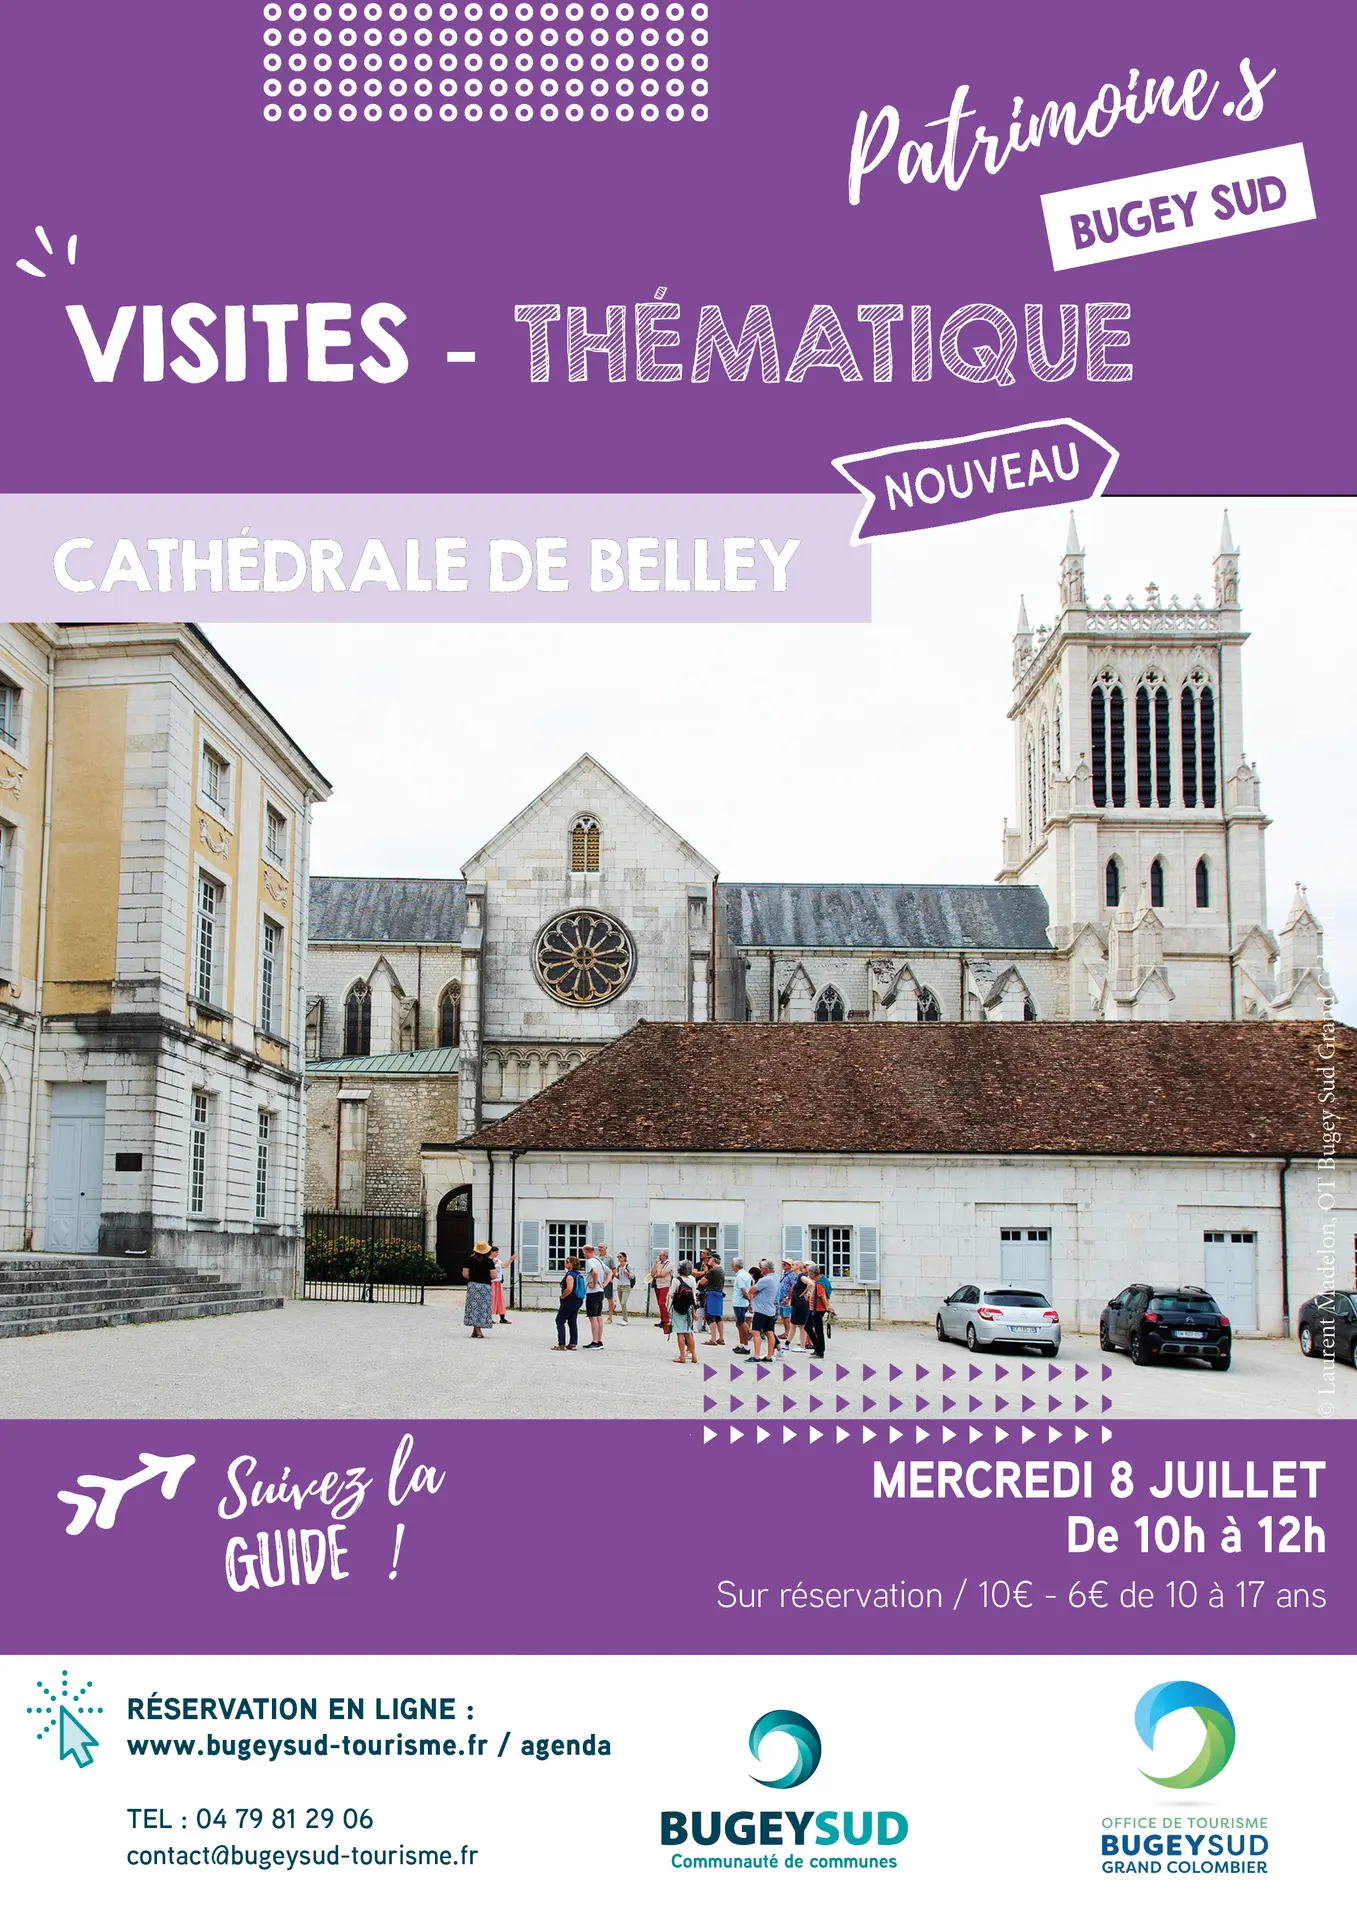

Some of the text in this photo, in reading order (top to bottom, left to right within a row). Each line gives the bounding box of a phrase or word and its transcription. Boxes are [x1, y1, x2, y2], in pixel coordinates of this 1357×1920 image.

[849, 57, 1277, 206] Patrimoine.s
[1070, 175, 1287, 251] BUGEY SUD
[65, 286, 1134, 387] VISITES - THÉMATIQUE
[884, 442, 1081, 511] NOUVEAU
[53, 526, 801, 593] CATHÉDRALE DE BELLEY
[217, 1432, 446, 1521] Suivez la
[873, 1460, 1327, 1499] MERCREDI 8 JUILLET
[1068, 1514, 1326, 1554] De 10h à 12h
[225, 1523, 406, 1593] GUIDE !
[717, 1580, 769, 1609] Sur
[780, 1580, 942, 1609] réservation
[953, 1577, 968, 1611] /
[978, 1580, 1033, 1609] 10€
[1068, 1580, 1109, 1609] 6€
[1120, 1580, 1154, 1609] de
[1166, 1580, 1198, 1609] 10
[1208, 1581, 1224, 1609] à
[1235, 1580, 1265, 1608] 17
[1276, 1588, 1327, 1609] ans
[127, 1691, 474, 1721] RÉSERVATION EN LIGNE :
[126, 1730, 612, 1762] www.bugeysud-tourisme.fr / agenda
[126, 1807, 374, 1830] TEL : 04 79 81 29 06
[660, 1810, 909, 1847] BUGEYSUD
[1101, 1817, 1268, 1829] OFFICE DE TOURISME
[126, 1843, 479, 1871] contact@bugeysud-tourisme.fr
[670, 1852, 898, 1869] Communauté de communes
[1101, 1833, 1269, 1857] BUGEYSUD
[1101, 1860, 1269, 1874] GRAND COLOMBIER
